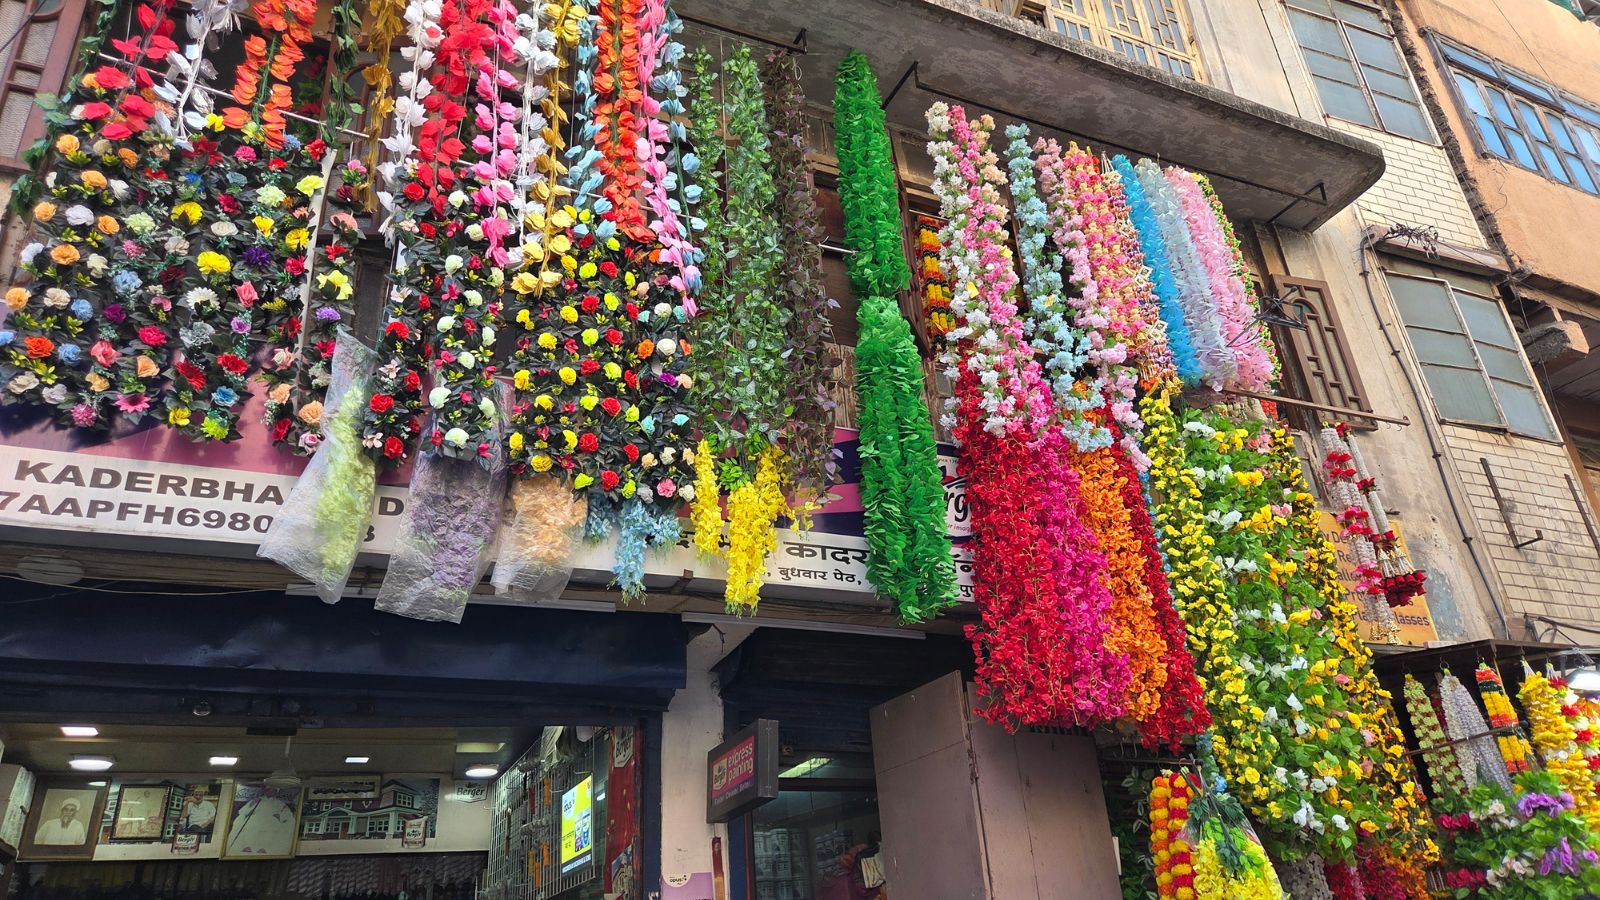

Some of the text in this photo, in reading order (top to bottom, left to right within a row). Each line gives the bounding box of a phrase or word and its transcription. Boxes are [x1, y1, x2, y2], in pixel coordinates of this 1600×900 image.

[14, 459, 286, 506] KADERBHA
[0, 491, 274, 534] 7AAPFH6980
[783, 541, 871, 565] कादर
[778, 567, 828, 581] बुधवार
[833, 568, 862, 586] पेठ,
[1394, 610, 1431, 626] lasses
[728, 757, 754, 785] painting
[456, 787, 486, 798] Berger
